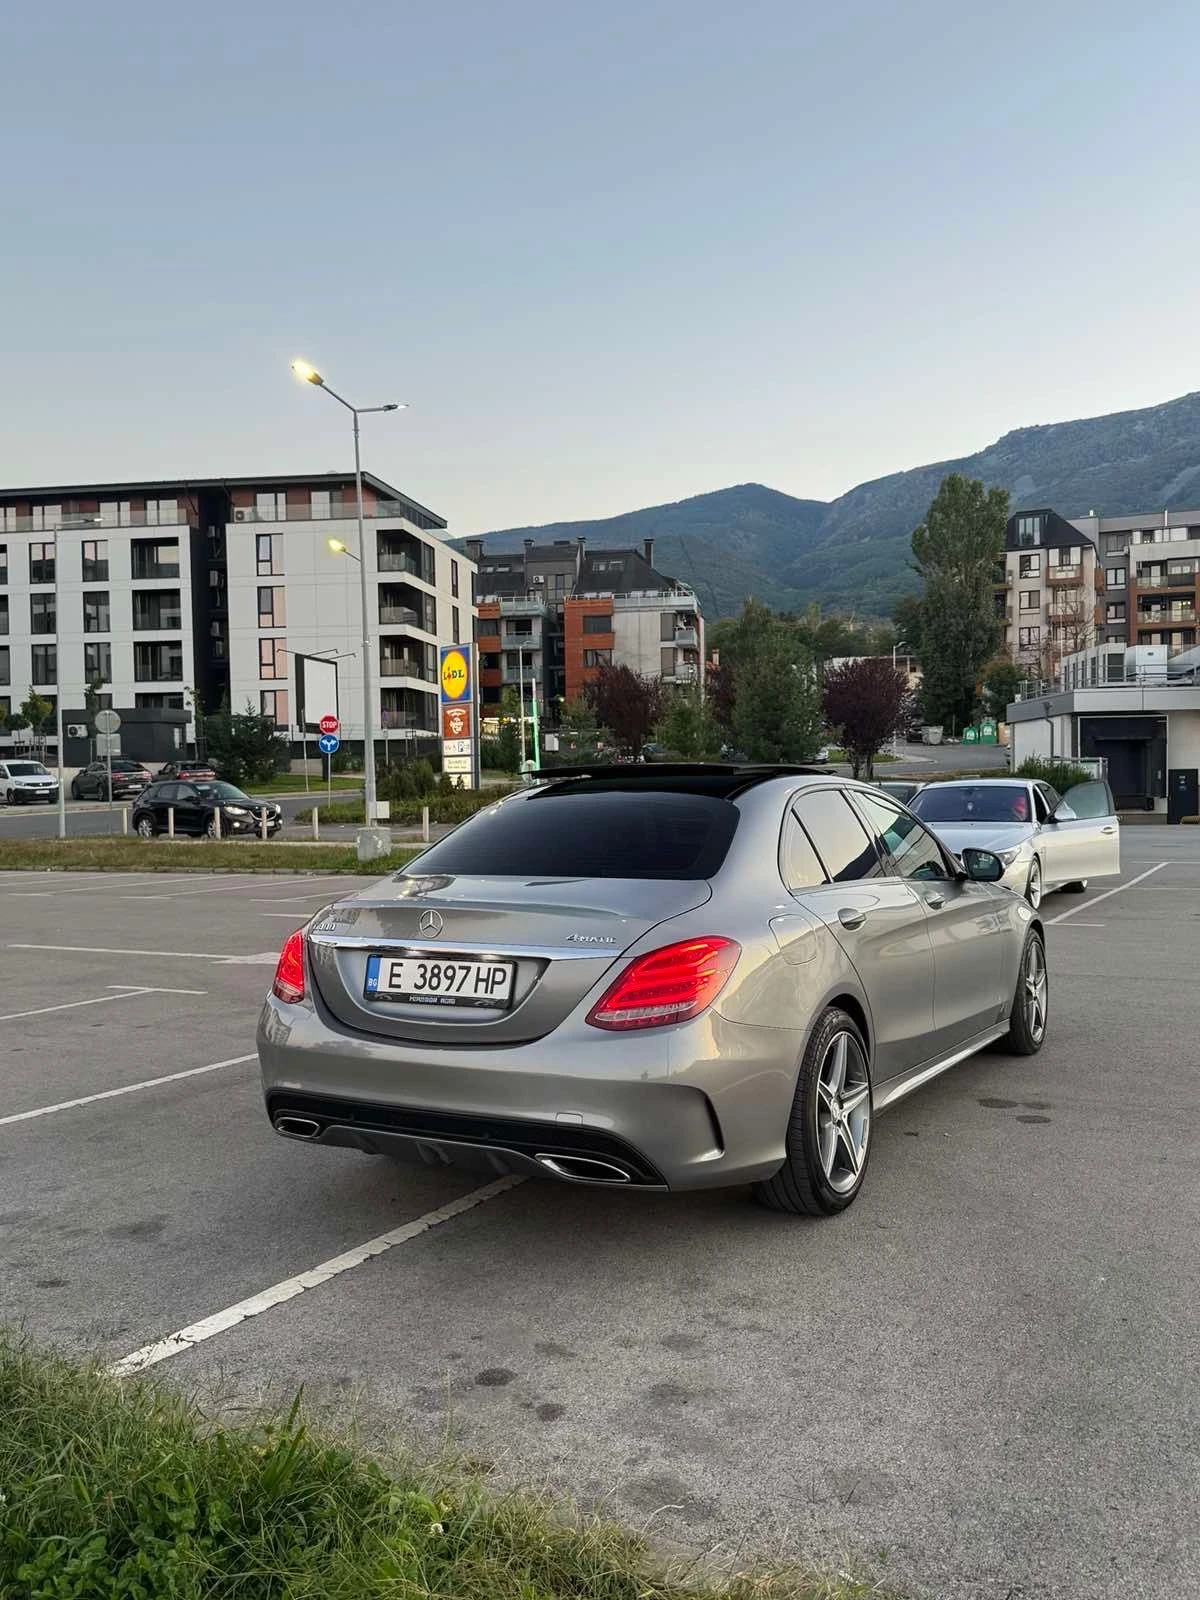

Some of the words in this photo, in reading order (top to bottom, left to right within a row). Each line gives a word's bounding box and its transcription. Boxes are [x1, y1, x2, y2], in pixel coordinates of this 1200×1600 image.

[321, 720, 338, 729] STOP
[368, 978, 378, 987] BG
[388, 962, 404, 989] E
[413, 964, 472, 992] 3897
[474, 967, 507, 994] HP
